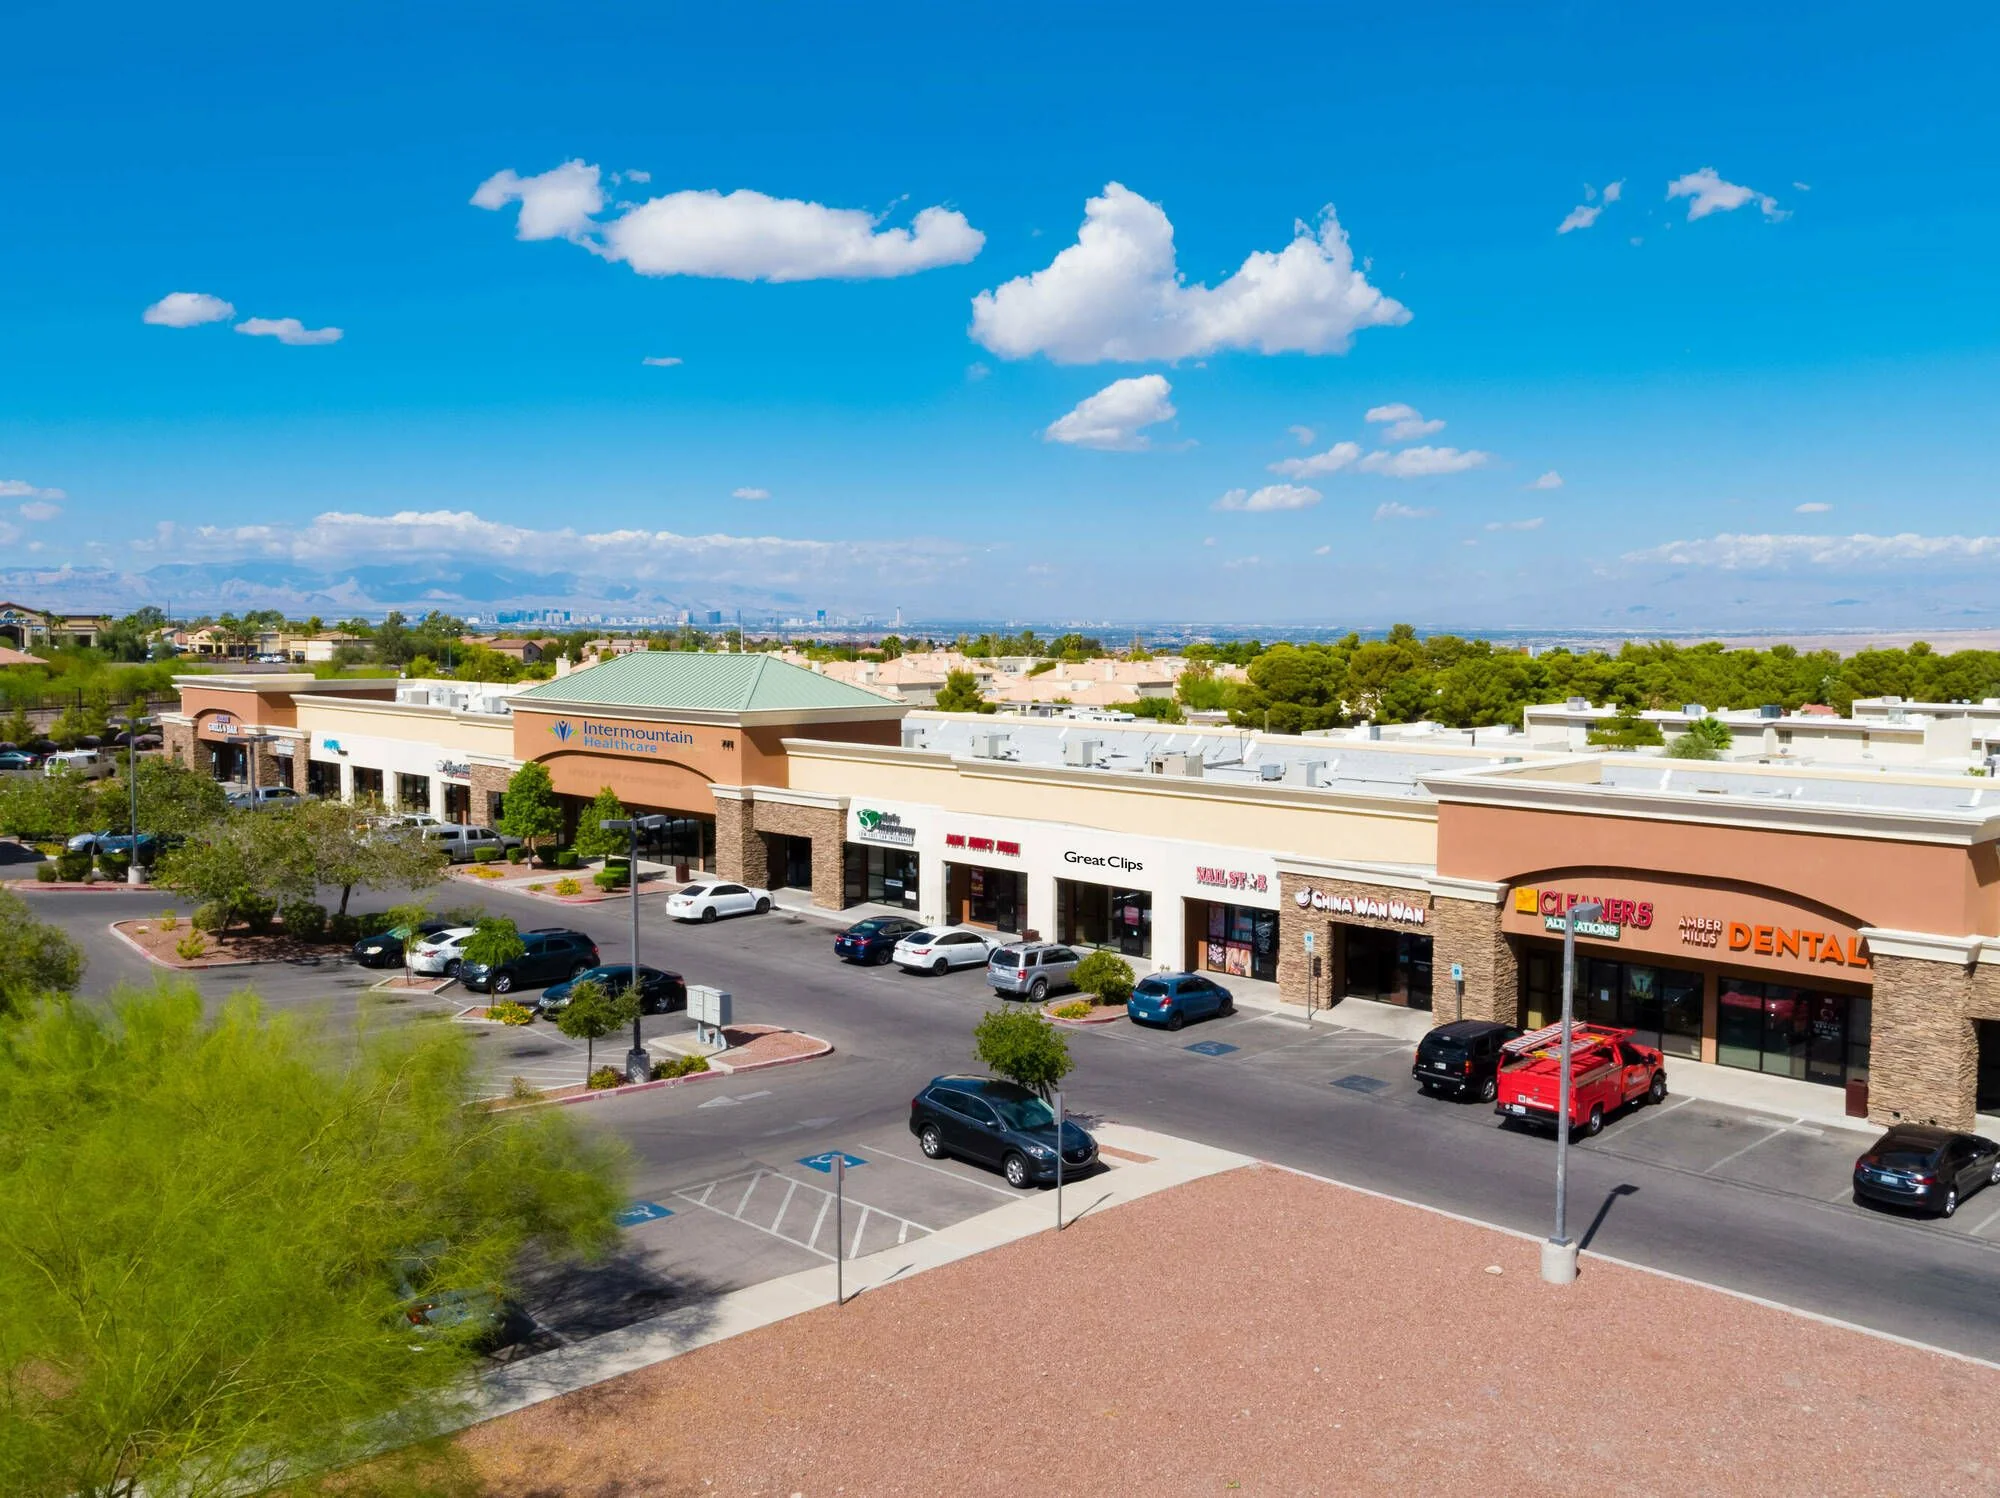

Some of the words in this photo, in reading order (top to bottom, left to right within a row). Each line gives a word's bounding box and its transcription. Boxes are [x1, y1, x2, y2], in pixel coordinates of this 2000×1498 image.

[584, 721, 693, 745] Intermountain
[584, 737, 657, 753] Healthcare
[1064, 851, 1105, 866] Great
[1107, 856, 1143, 872] Clips
[1196, 866, 1226, 885] NAIL
[1311, 890, 1353, 913] CHINA
[1354, 897, 1388, 919] WAN
[1390, 901, 1424, 923] WAN
[1546, 918, 1617, 937] ALTATIONS
[1678, 917, 1722, 931] AMBER
[1681, 930, 1717, 944] HILLS
[1728, 922, 1868, 965] DENTAL
